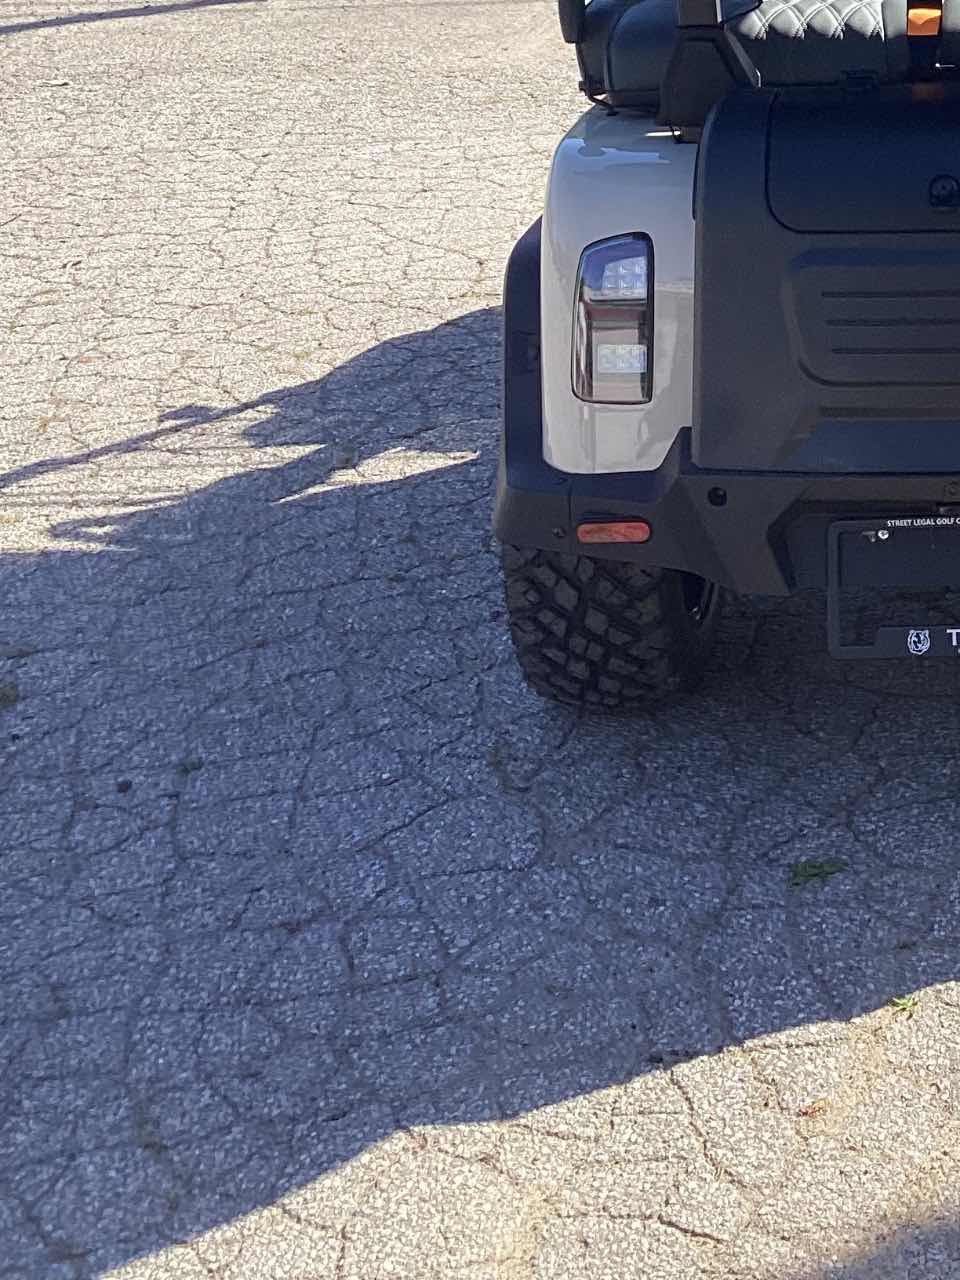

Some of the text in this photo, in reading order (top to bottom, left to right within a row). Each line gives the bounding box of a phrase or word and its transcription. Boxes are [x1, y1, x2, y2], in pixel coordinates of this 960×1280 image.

[887, 519, 912, 527] STREET
[913, 518, 936, 526] LEGAL
[936, 517, 956, 525] GOLF
